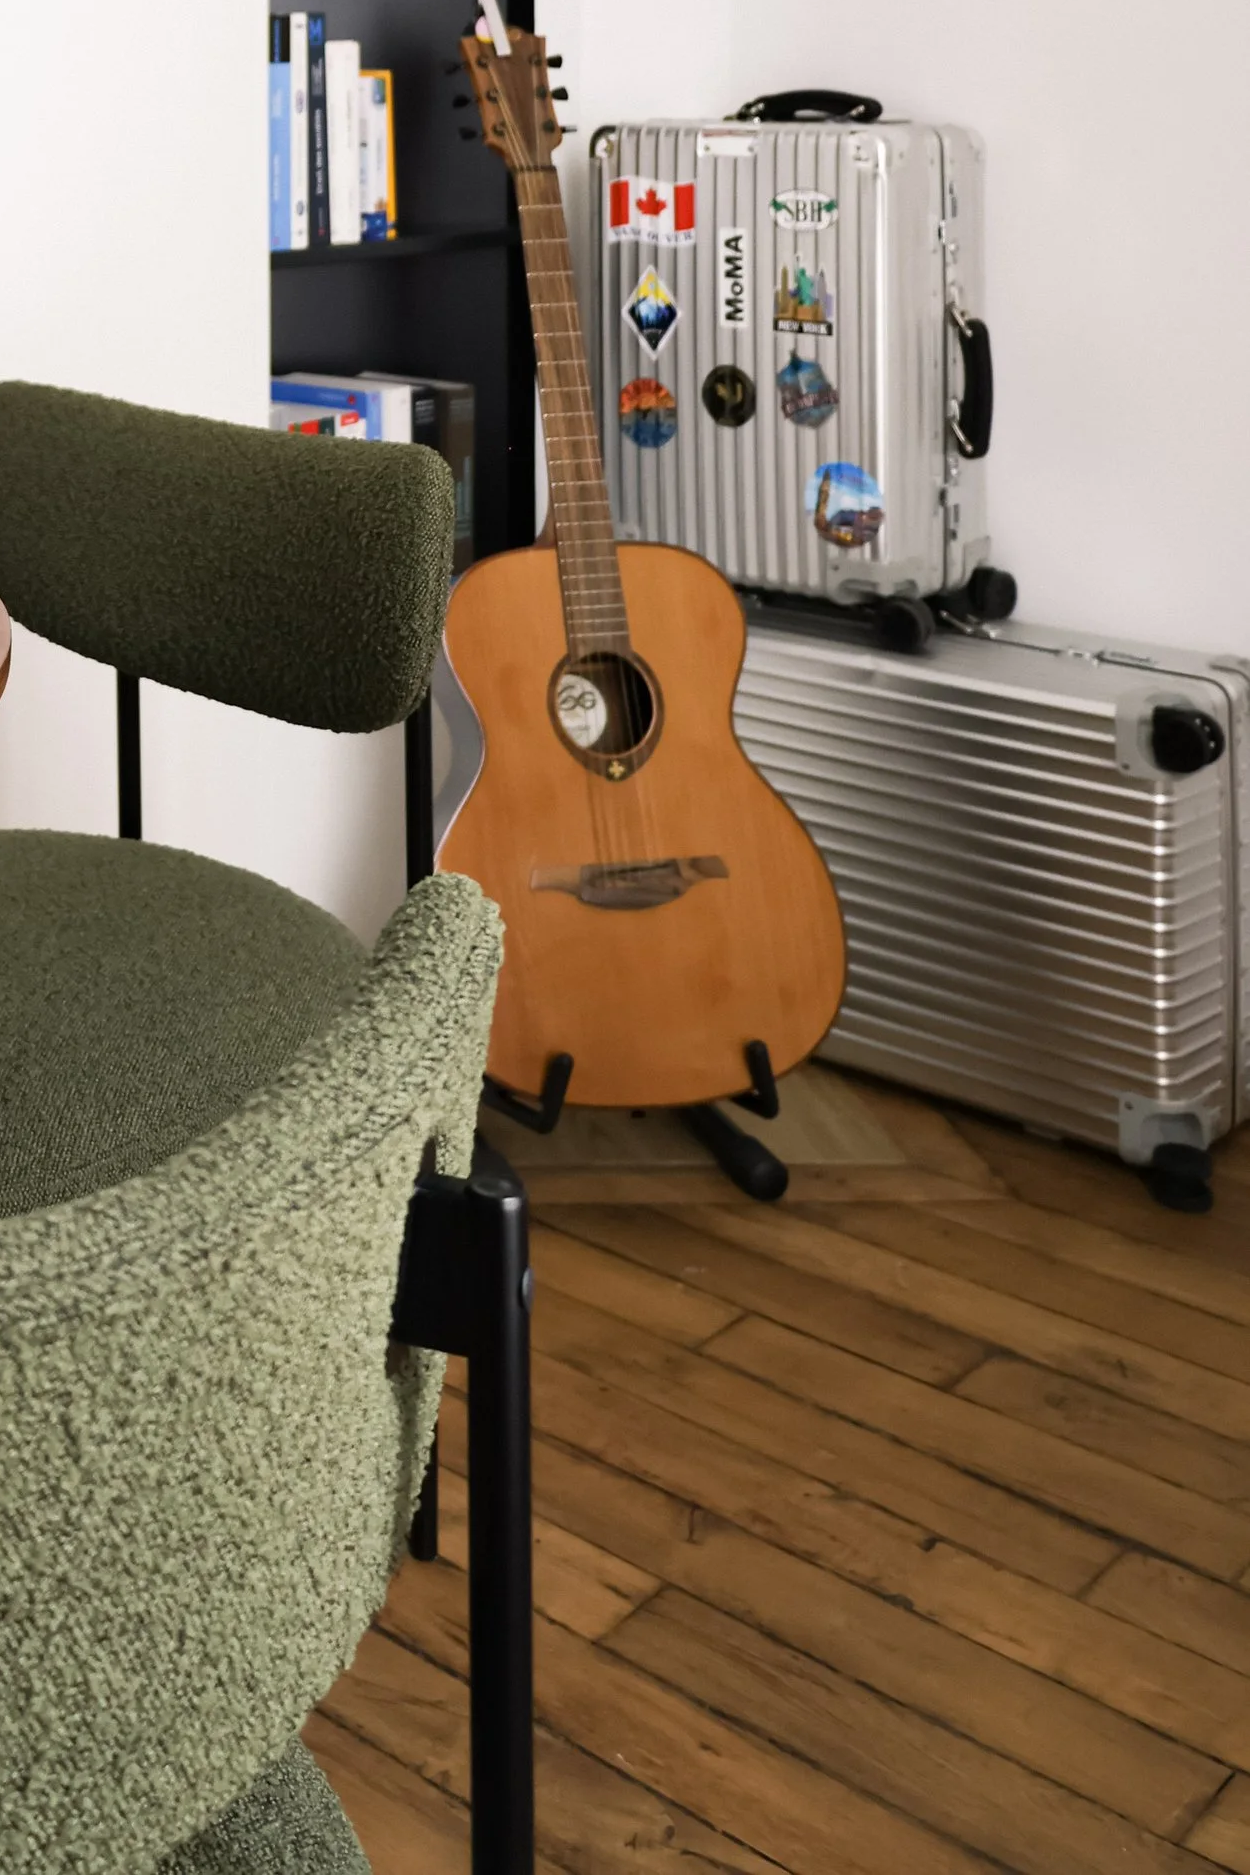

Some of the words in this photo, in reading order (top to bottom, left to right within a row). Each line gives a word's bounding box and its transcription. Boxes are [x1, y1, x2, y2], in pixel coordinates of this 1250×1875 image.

[784, 199, 823, 223] SBH
[724, 234, 744, 322] MoMA
[778, 319, 799, 331] NEW
[802, 321, 828, 334] YORK
